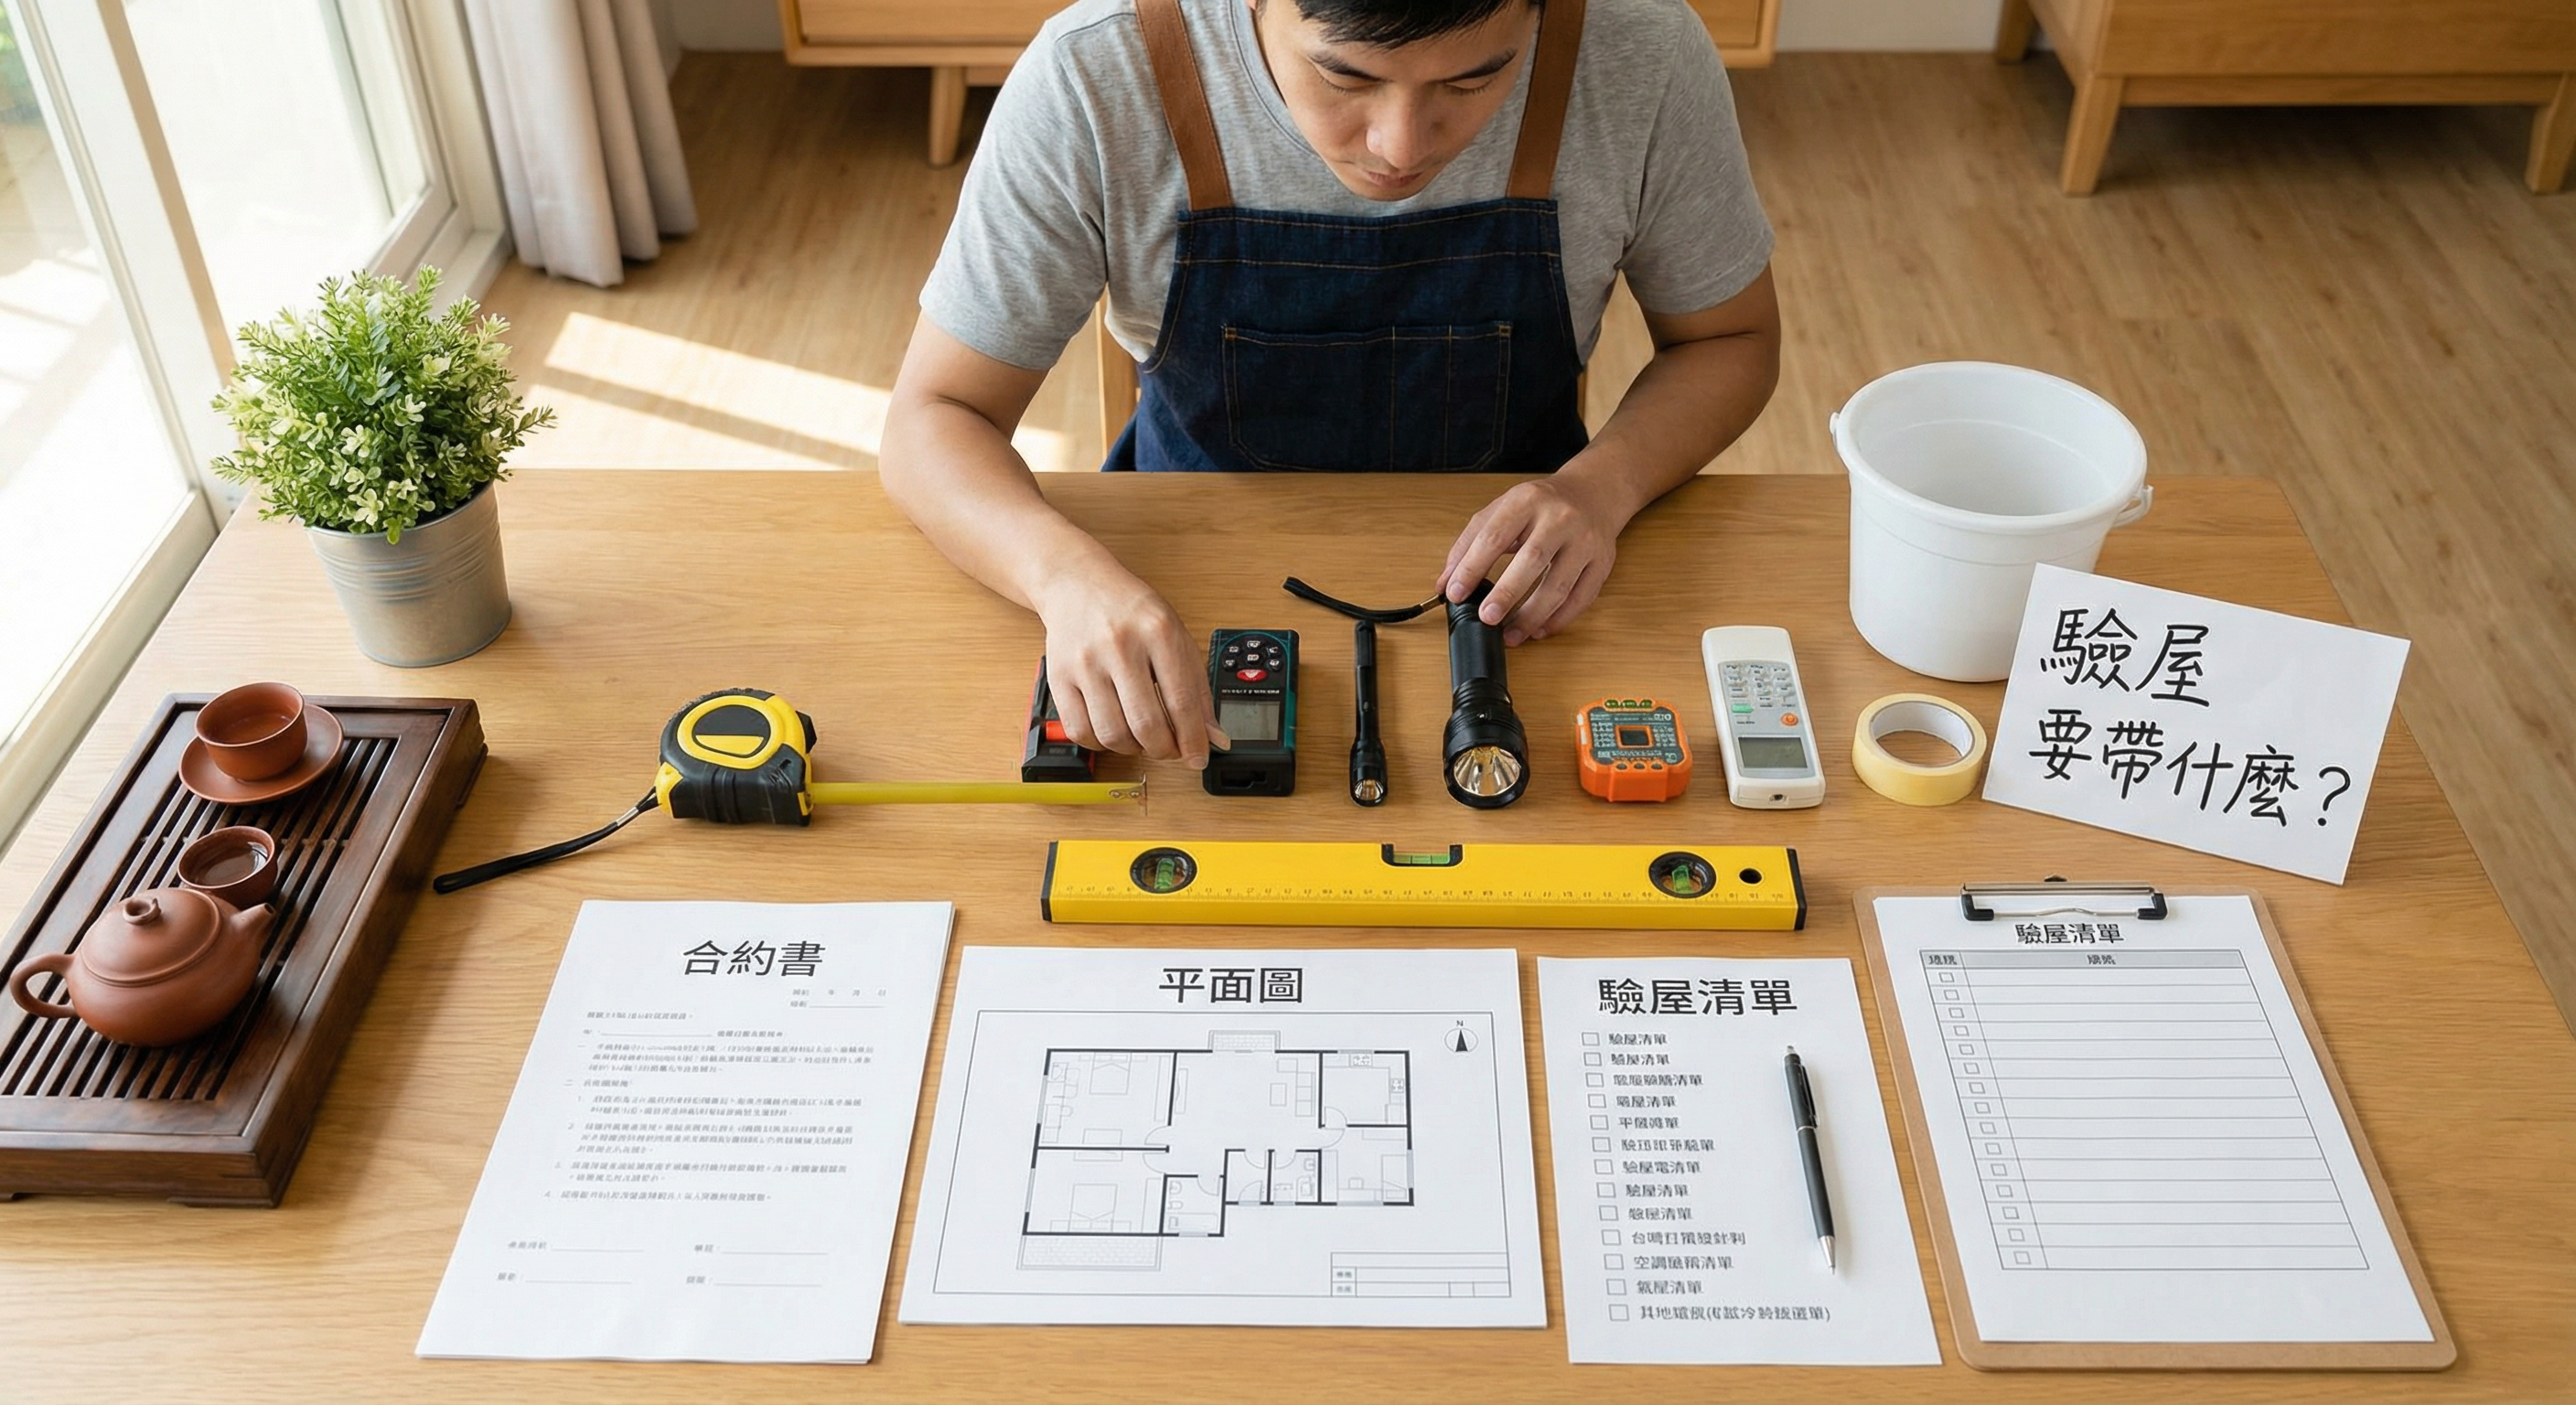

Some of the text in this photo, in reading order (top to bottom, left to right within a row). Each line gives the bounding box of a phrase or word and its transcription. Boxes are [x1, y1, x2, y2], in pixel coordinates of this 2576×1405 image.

[2040, 607, 2210, 707] 驗屋
[2028, 708, 2352, 827] 要帶什麼？
[2014, 922, 2125, 945] 驗屋清單
[682, 939, 826, 977] 合約書
[1158, 967, 1304, 1004] 平面圖
[1598, 978, 1799, 1016] 驗屋清單
